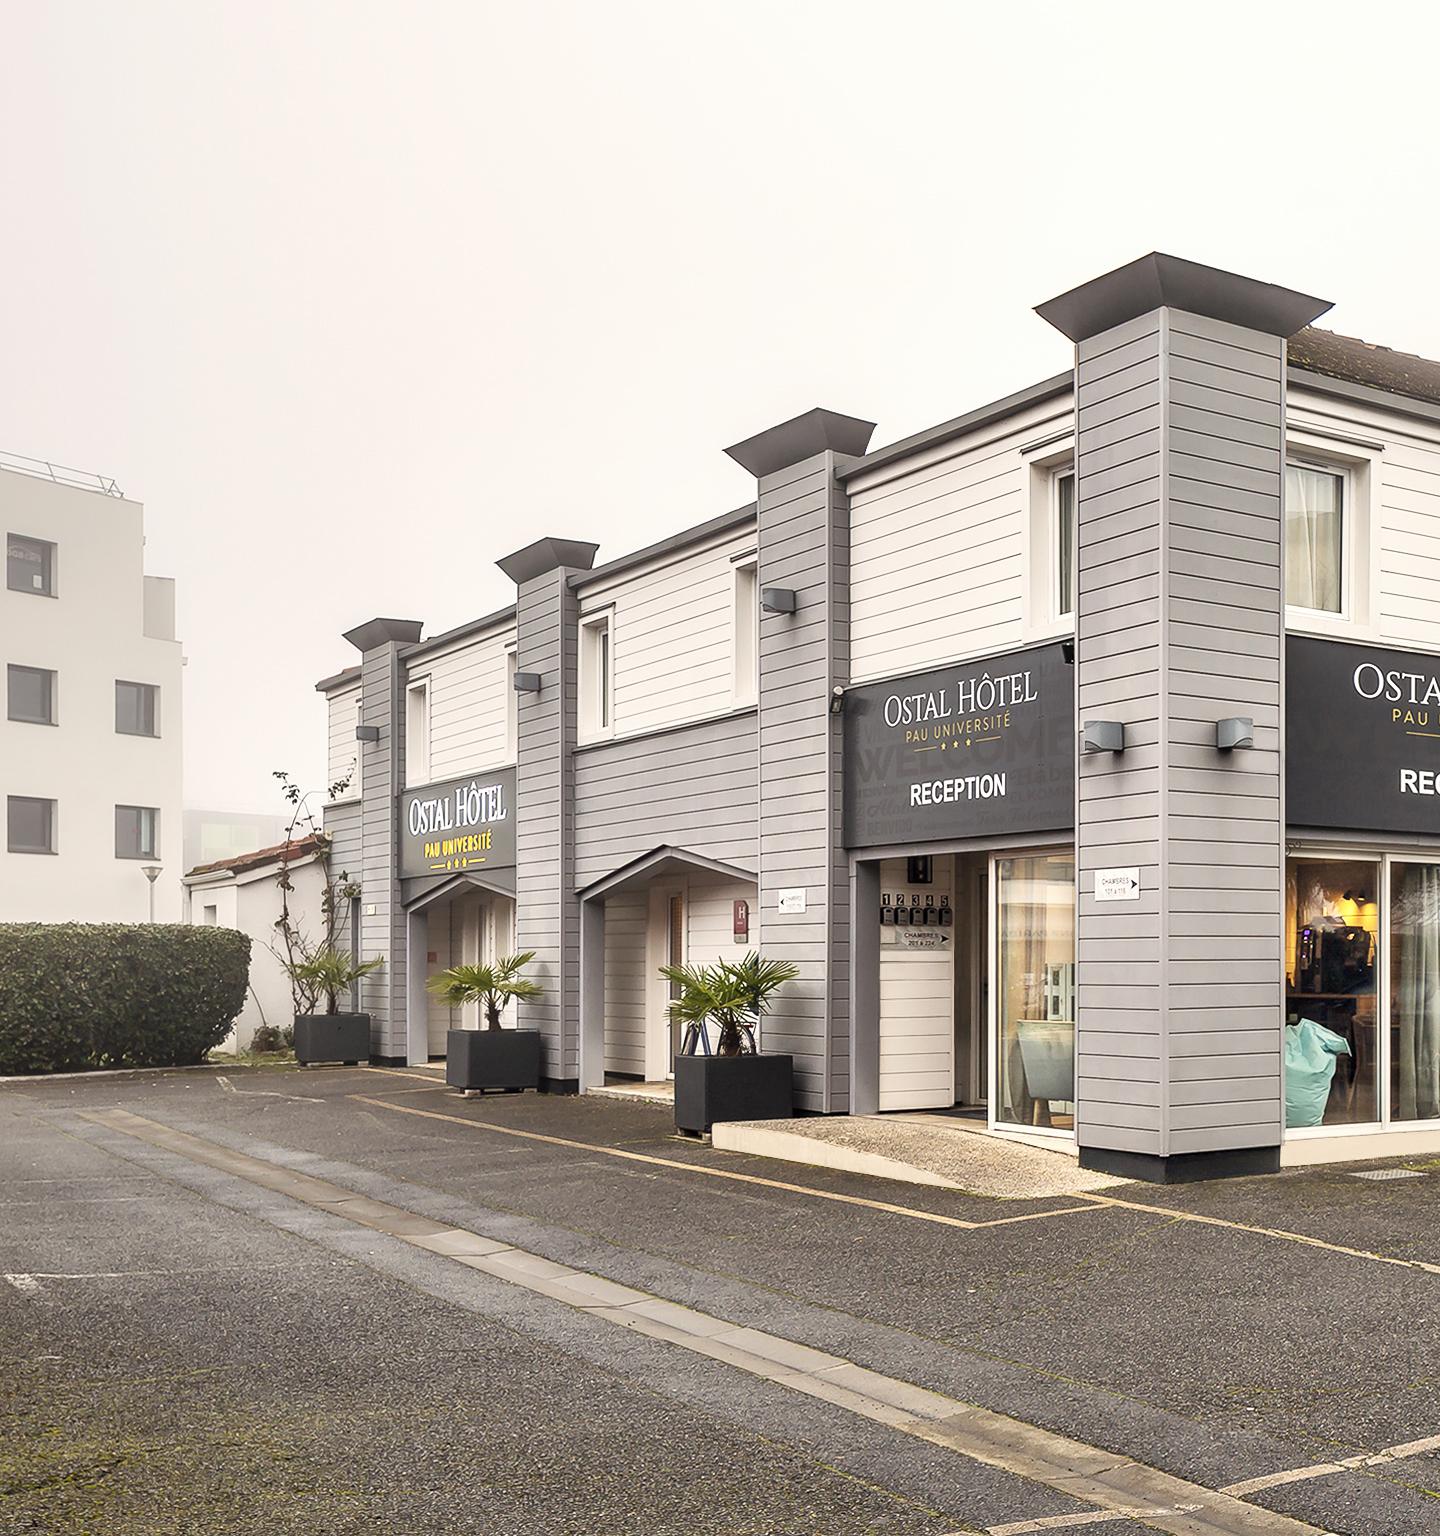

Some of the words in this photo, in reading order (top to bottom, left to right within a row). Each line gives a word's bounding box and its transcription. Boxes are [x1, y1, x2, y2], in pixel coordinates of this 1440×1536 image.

[883, 689, 952, 728] OSTAL
[957, 671, 1038, 715] HÔTEL
[905, 726, 929, 743] PAU
[933, 709, 1011, 738] UNIVERSITÉ
[1392, 708, 1429, 727] PAU
[910, 772, 1007, 807] RECEPTION
[409, 797, 453, 836] OSTAL
[455, 781, 507, 828] HÔTEL
[424, 841, 440, 858] PAU
[442, 828, 493, 857] UNIVERSITÉ
[738, 906, 745, 919] H
